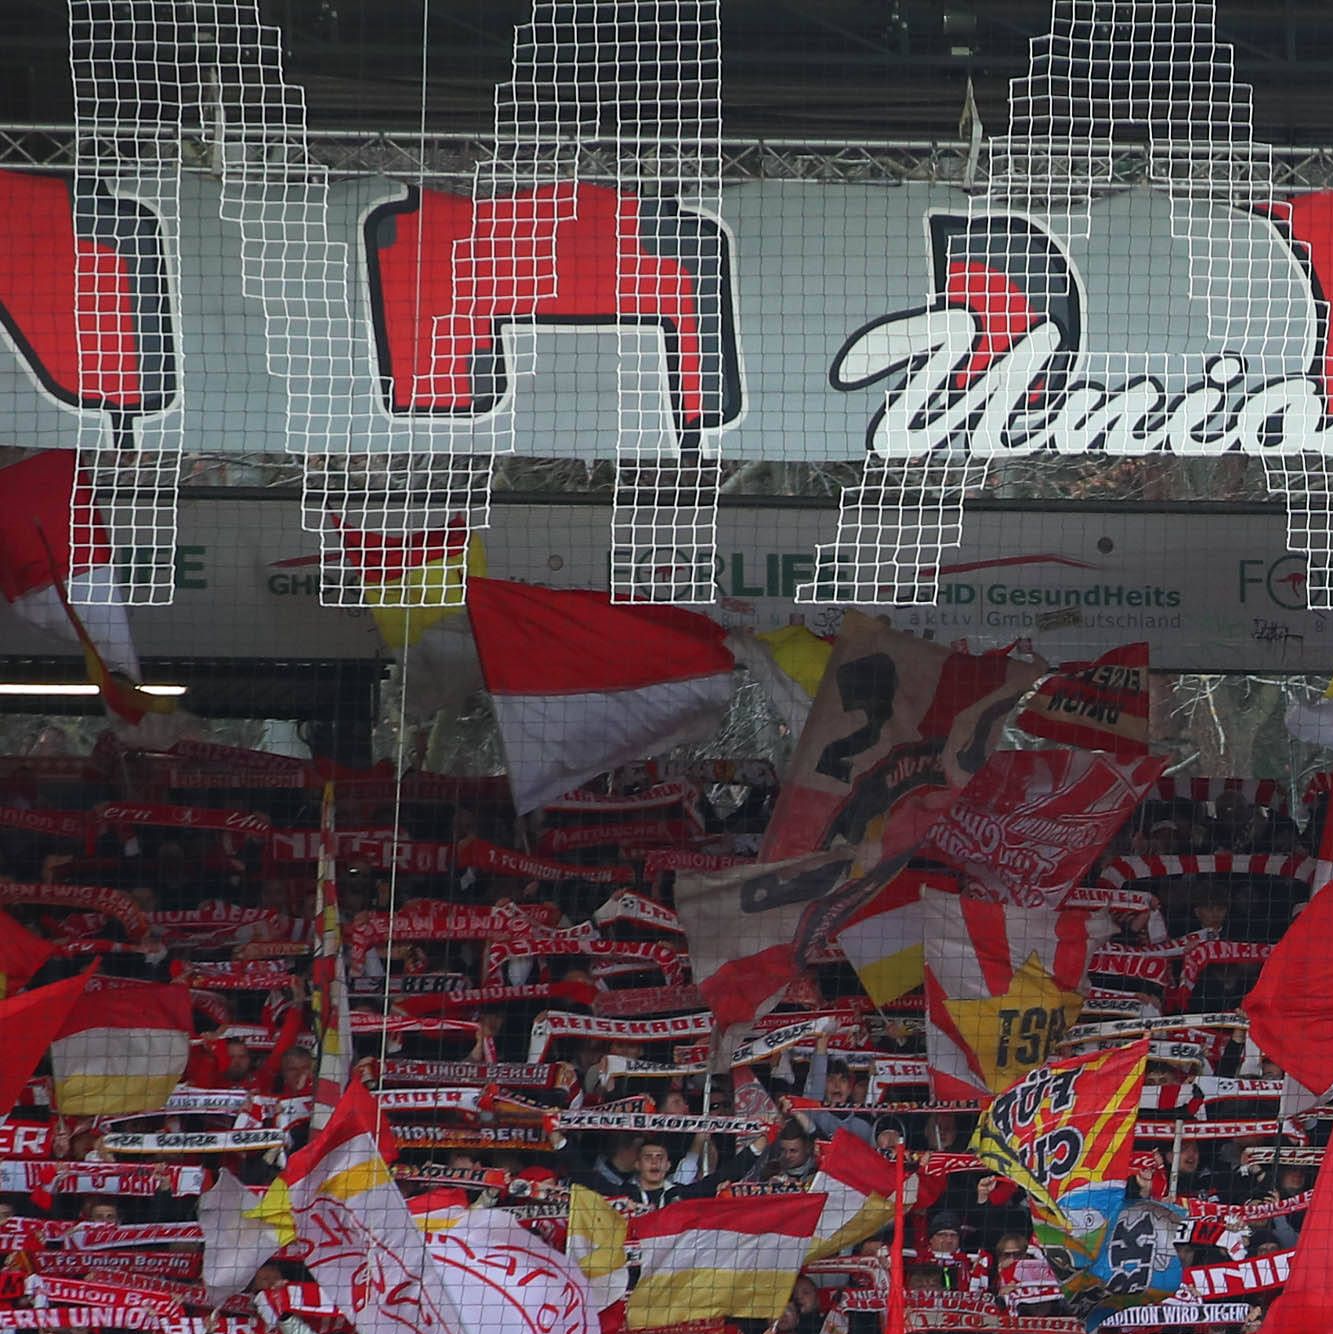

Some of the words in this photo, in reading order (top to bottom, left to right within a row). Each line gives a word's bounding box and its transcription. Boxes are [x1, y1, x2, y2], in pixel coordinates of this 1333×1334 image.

[987, 584, 1181, 608] GesundHeits
[81, 1254, 131, 1267] Union
[136, 1254, 192, 1270] Berlin
[1157, 1305, 1198, 1323] WIRD
